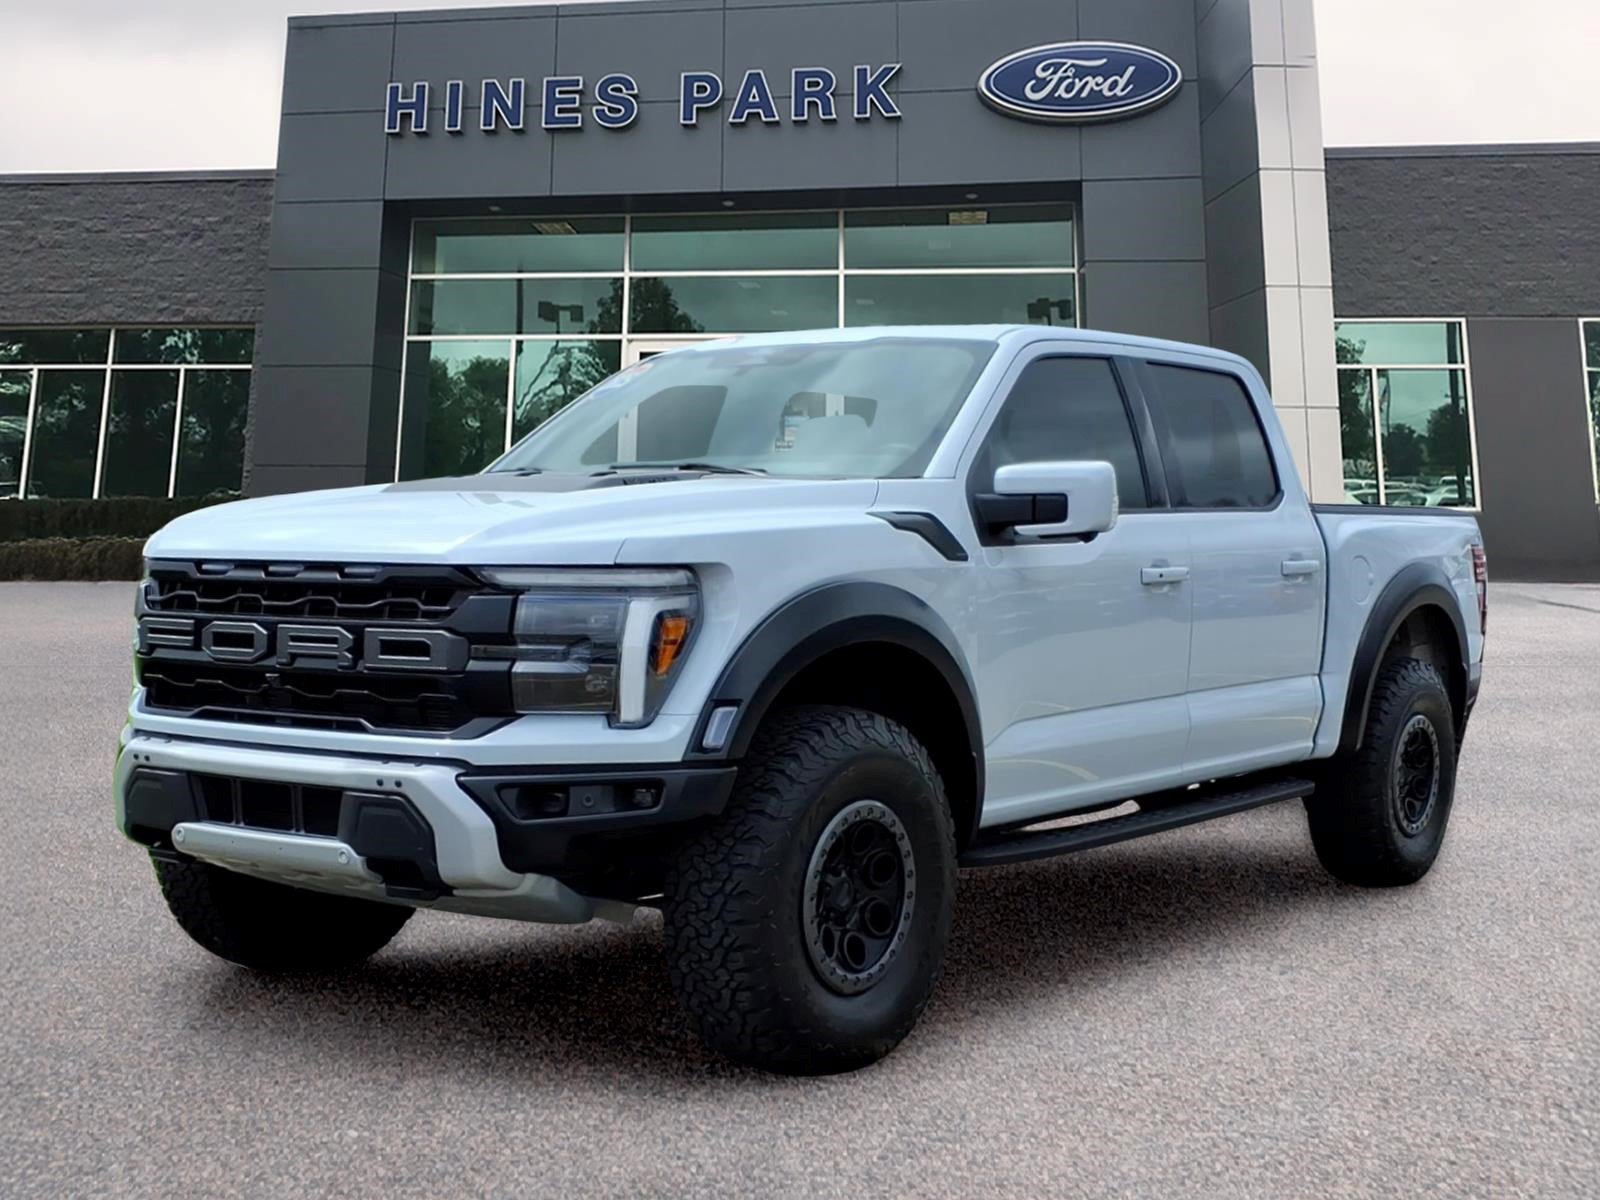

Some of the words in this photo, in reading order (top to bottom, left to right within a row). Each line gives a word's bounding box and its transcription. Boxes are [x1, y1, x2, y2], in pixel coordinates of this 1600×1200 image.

[384, 73, 639, 134] HINES
[679, 63, 903, 126] PARK
[1024, 58, 1136, 100] Ford
[138, 617, 470, 676] FORD
